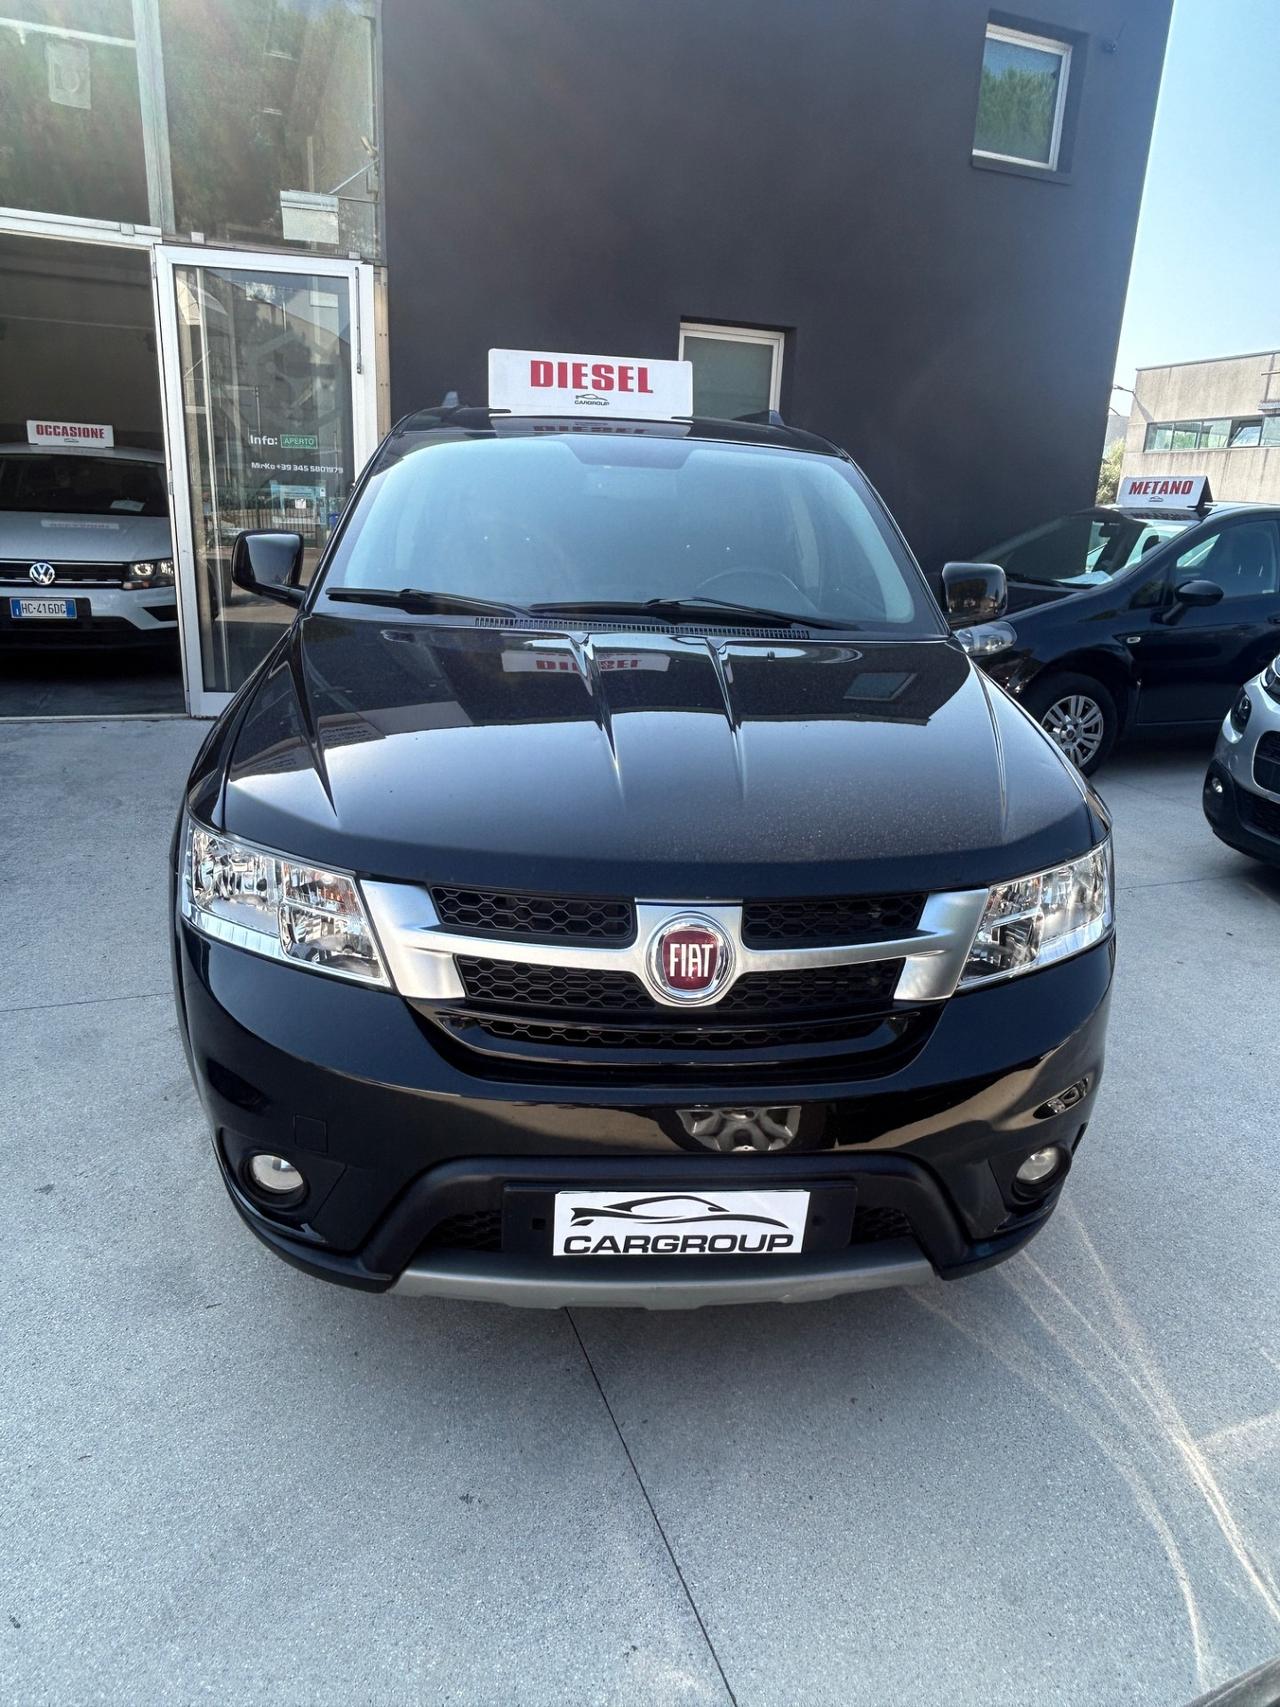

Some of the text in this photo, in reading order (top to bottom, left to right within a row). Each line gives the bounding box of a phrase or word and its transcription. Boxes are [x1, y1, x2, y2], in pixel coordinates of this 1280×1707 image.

[530, 360, 654, 394] DIESEL
[35, 424, 105, 440] OCCASIONE
[249, 434, 315, 446] Info: APERTO
[276, 463, 292, 472] +39
[293, 464, 309, 473] 345
[1127, 480, 1194, 496] METANO
[669, 943, 714, 978] FIAT
[563, 1233, 795, 1255] CARGROUP
